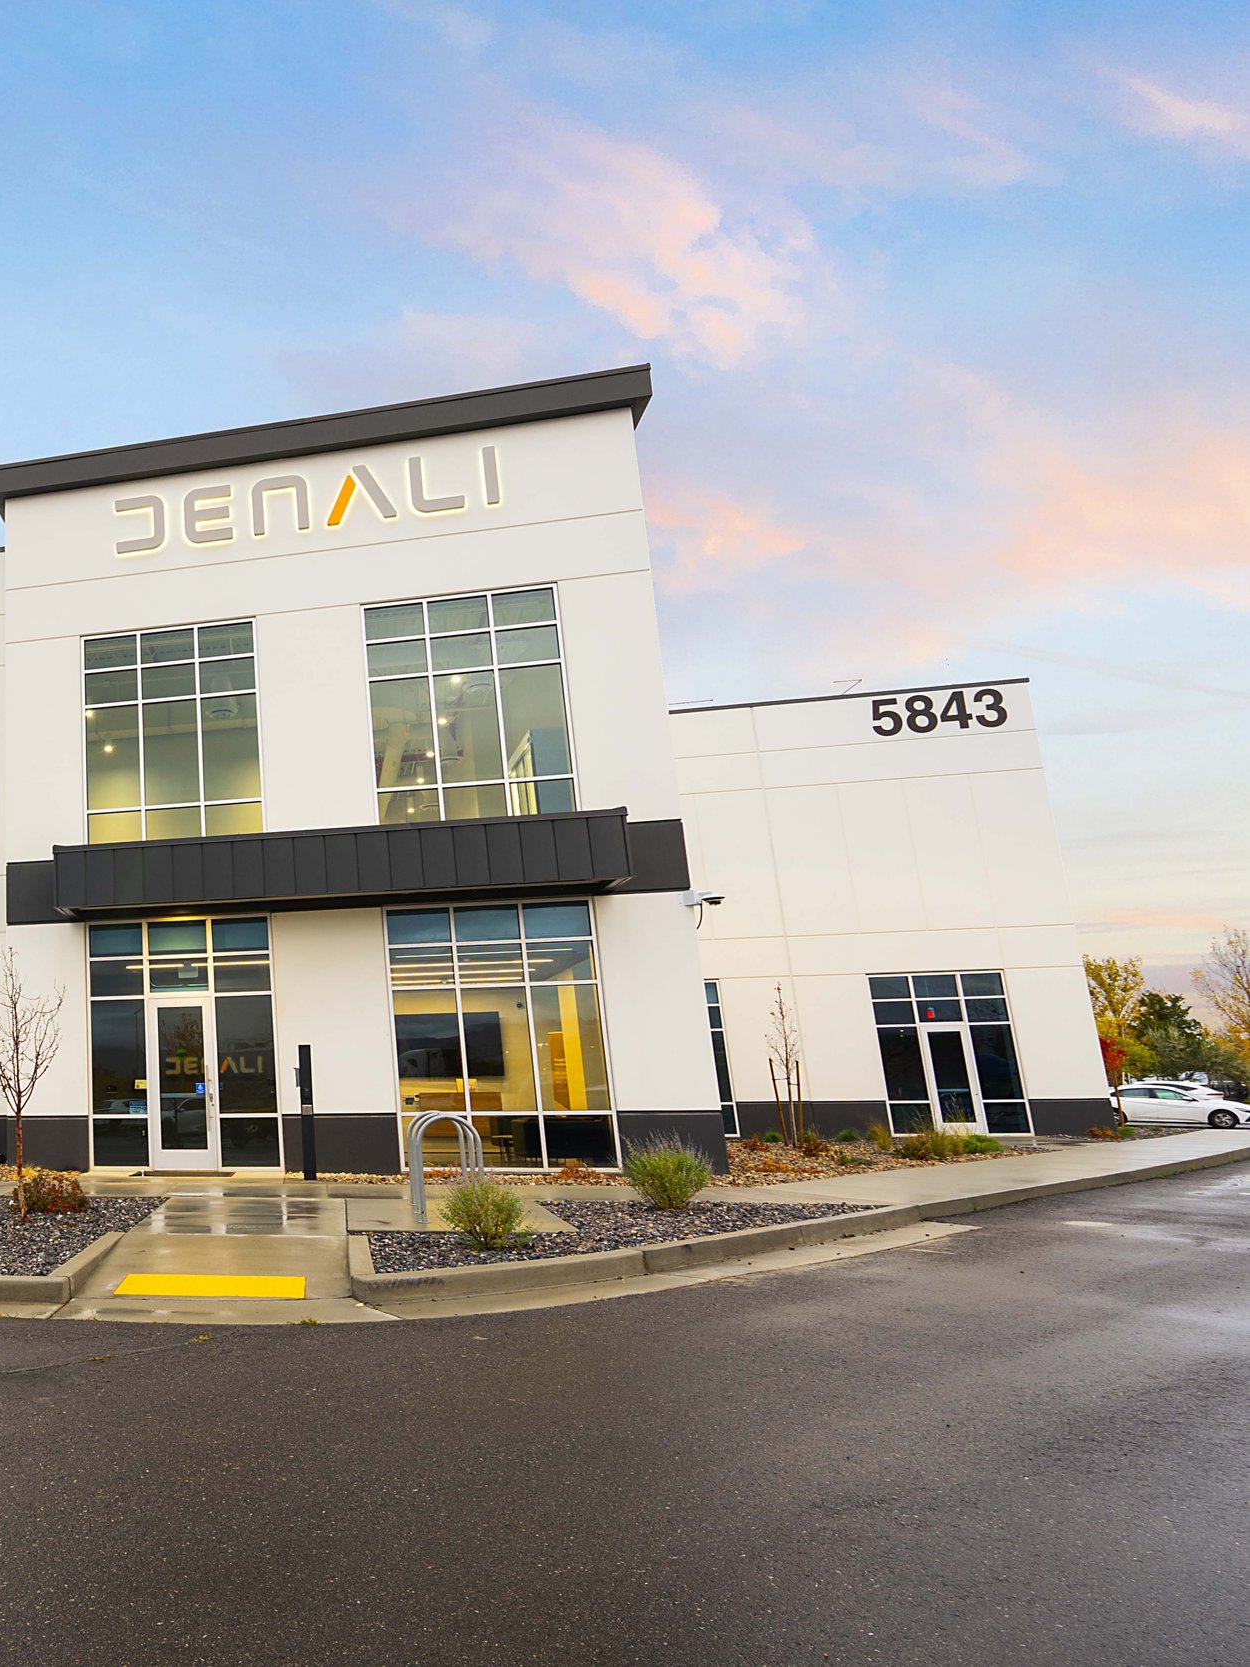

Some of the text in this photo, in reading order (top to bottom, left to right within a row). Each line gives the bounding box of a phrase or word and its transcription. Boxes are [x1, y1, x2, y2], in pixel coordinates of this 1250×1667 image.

[114, 445, 500, 555] DENALI
[872, 688, 1007, 736] 5843
[165, 1055, 264, 1075] DEALI
